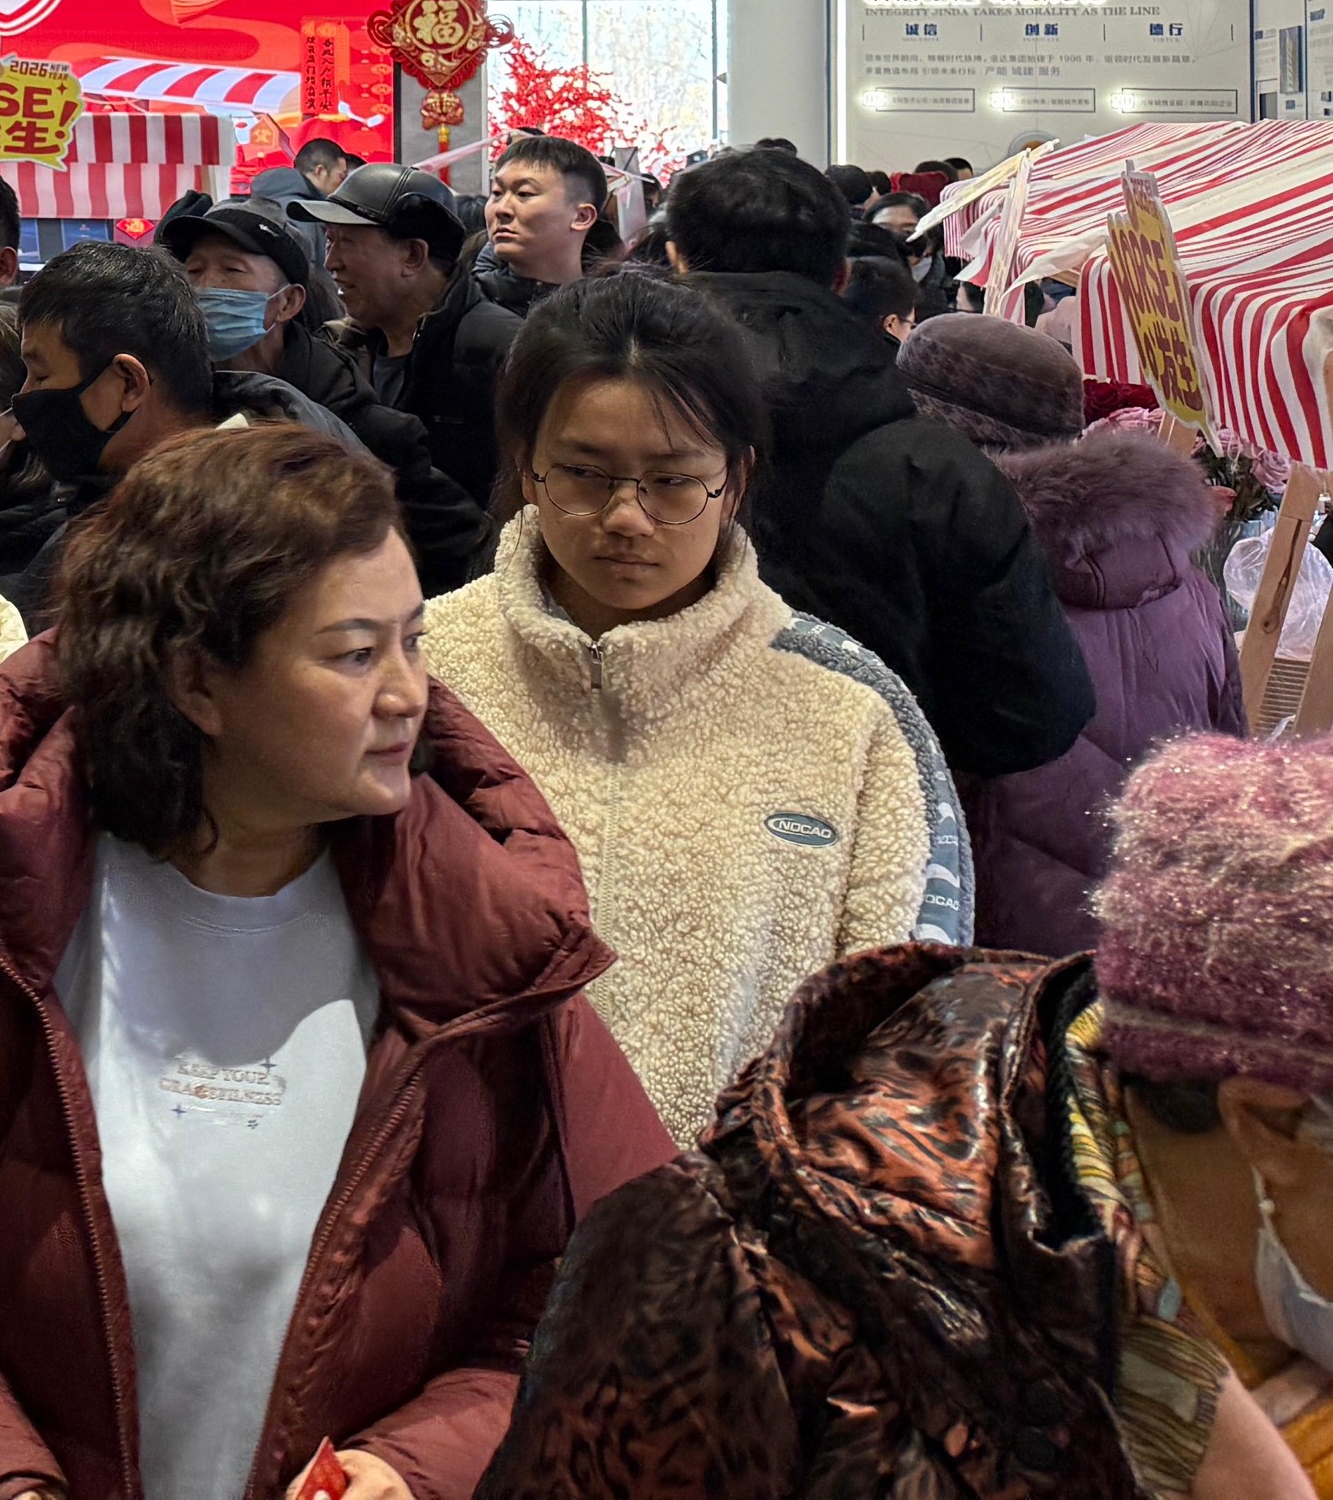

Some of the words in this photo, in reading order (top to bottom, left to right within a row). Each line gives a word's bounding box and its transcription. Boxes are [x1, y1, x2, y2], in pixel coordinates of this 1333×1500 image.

[865, 8, 928, 17] INTEGRITY
[932, 8, 968, 17] JINDA
[973, 8, 1012, 16] TAKES
[1015, 7, 1079, 16] MORALITY
[1082, 7, 1099, 16] AS
[1102, 7, 1127, 16] THE
[1130, 6, 1160, 15] LINE
[413, 0, 464, 45] 福
[10, 60, 47, 77] 2026
[49, 64, 69, 72] NEW
[48, 71, 68, 81] YEAR
[925, 894, 960, 911] OCAO
